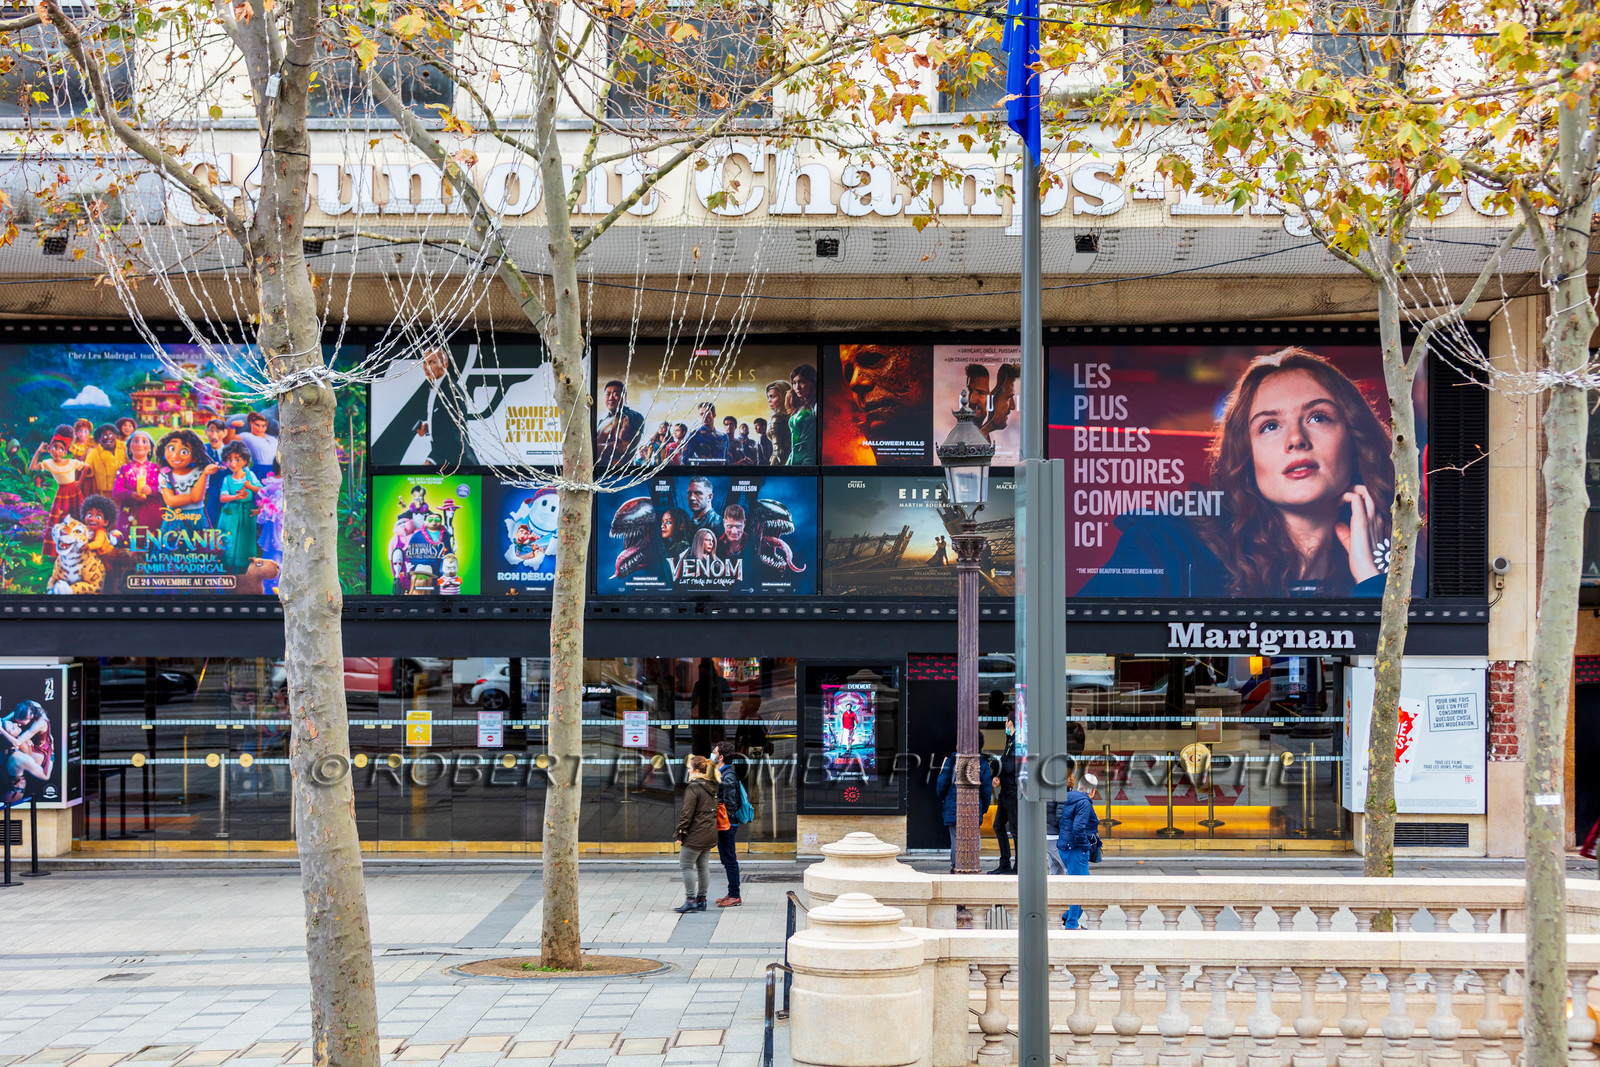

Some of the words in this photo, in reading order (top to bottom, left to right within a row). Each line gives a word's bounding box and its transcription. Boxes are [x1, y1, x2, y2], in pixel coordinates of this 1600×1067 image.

[165, 151, 659, 225] Gumont
[1073, 363, 1111, 388] LES
[1073, 395, 1128, 420] PLUS
[505, 418, 546, 430] PEUT
[1073, 426, 1151, 452] BELLES
[1073, 458, 1185, 485] HISTOIRES
[1073, 490, 1224, 516] COMMENCENT
[129, 525, 233, 552] ENCANTO
[136, 563, 174, 573] FAMILLE
[175, 563, 227, 573] MADRIGAL
[145, 553, 157, 562] LA
[666, 547, 743, 582] VENOM
[130, 578, 139, 586] LE
[141, 578, 150, 586] 24
[152, 578, 191, 586] NOVEMBRE
[193, 578, 203, 586] AU
[205, 577, 233, 586] CINÉMA
[497, 572, 519, 581] RON
[521, 571, 555, 581] DÉBLO
[1167, 622, 1356, 655] Marignan
[45, 680, 54, 690] 21
[45, 690, 54, 700] 22
